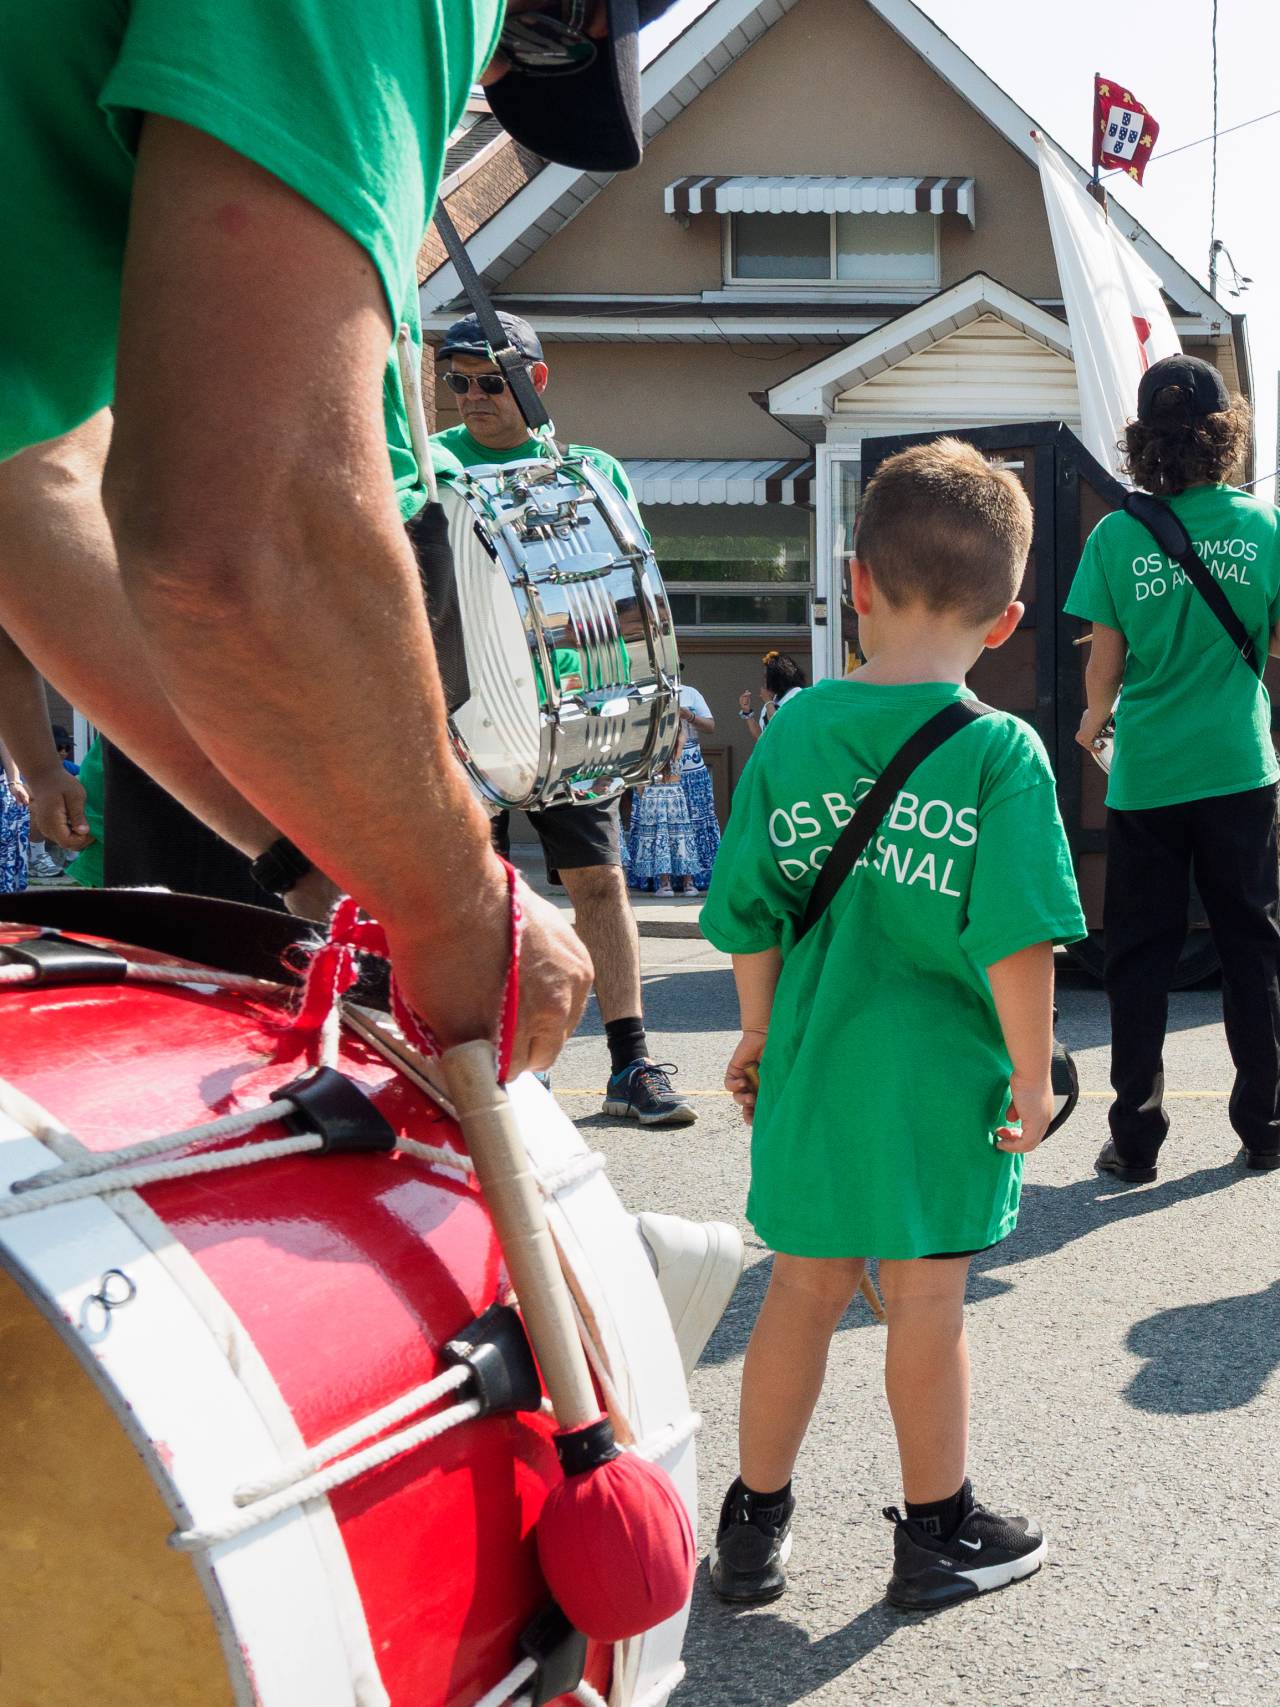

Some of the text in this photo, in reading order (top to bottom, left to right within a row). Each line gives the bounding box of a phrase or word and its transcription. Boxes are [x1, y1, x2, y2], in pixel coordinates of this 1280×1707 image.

[1132, 553, 1163, 576] OS
[1136, 577, 1167, 601] DO
[768, 801, 822, 847] OS
